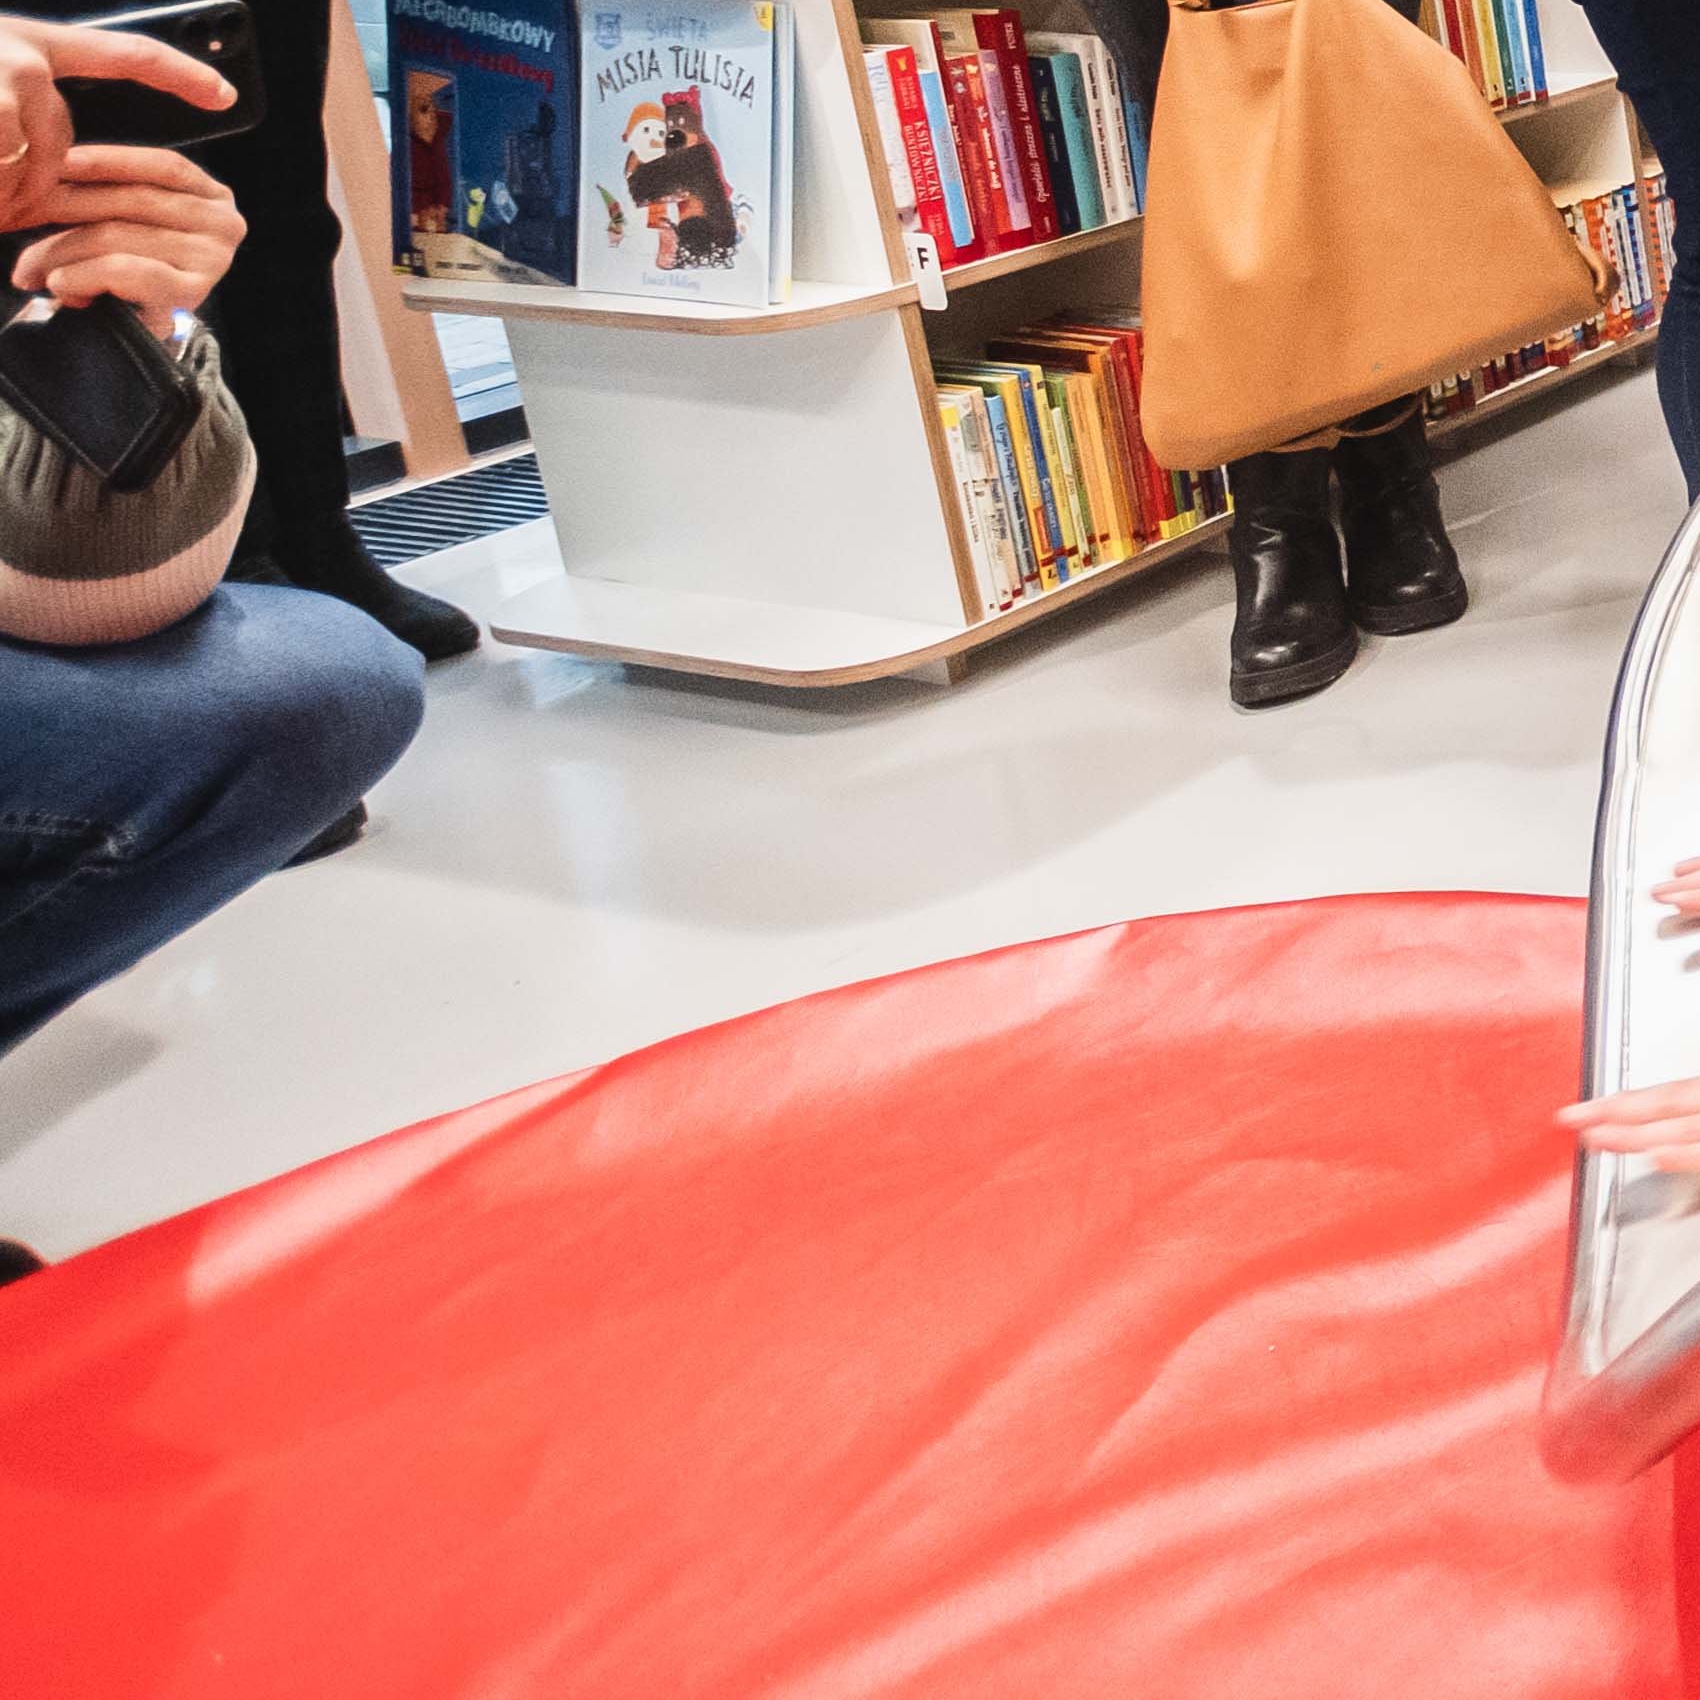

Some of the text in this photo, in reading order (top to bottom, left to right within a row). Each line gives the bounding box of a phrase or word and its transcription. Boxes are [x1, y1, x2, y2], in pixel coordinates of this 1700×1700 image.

[596, 48, 663, 102] MISIA
[668, 45, 756, 110] TULISIA
[917, 247, 929, 270] F
